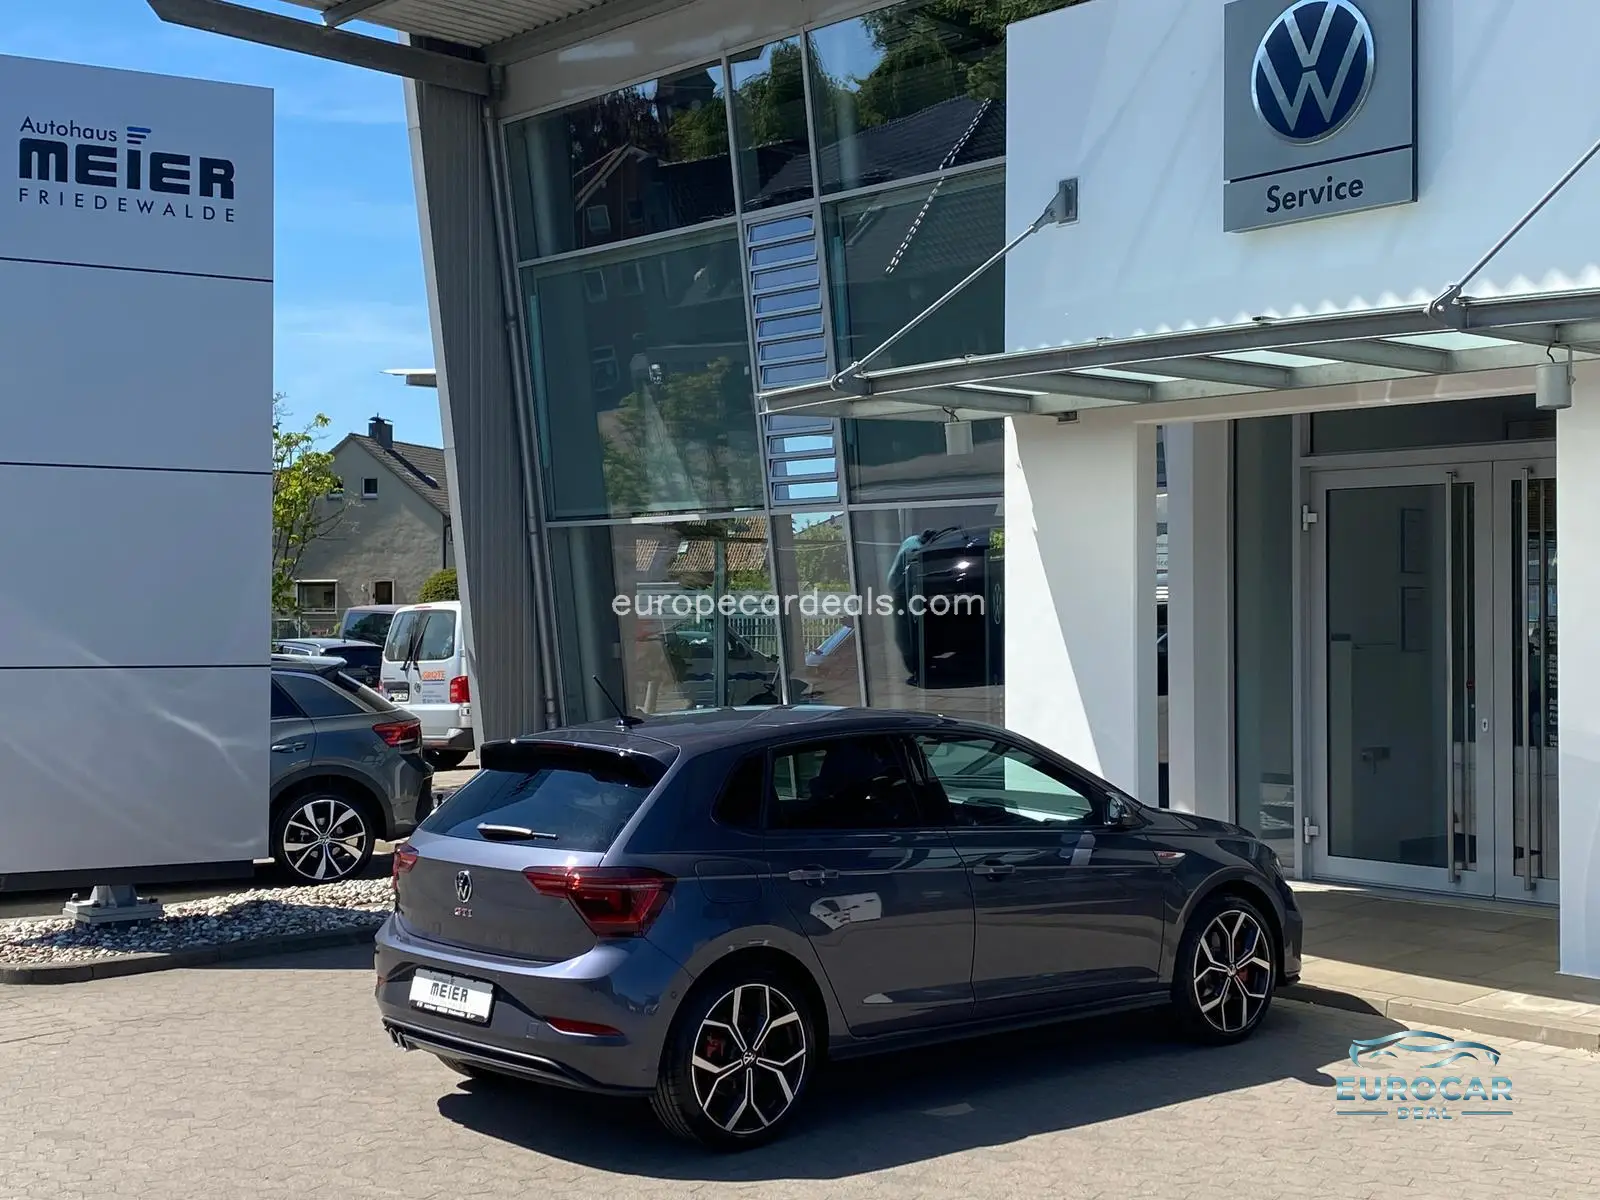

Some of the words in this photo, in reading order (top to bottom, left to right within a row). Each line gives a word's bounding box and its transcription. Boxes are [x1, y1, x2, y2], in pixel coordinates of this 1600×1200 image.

[19, 115, 118, 142] Autohaus
[19, 127, 235, 200] MEIER
[19, 187, 235, 222] FRIEDEWALDE
[1266, 175, 1365, 213] Service
[430, 982, 469, 1003] MEIER
